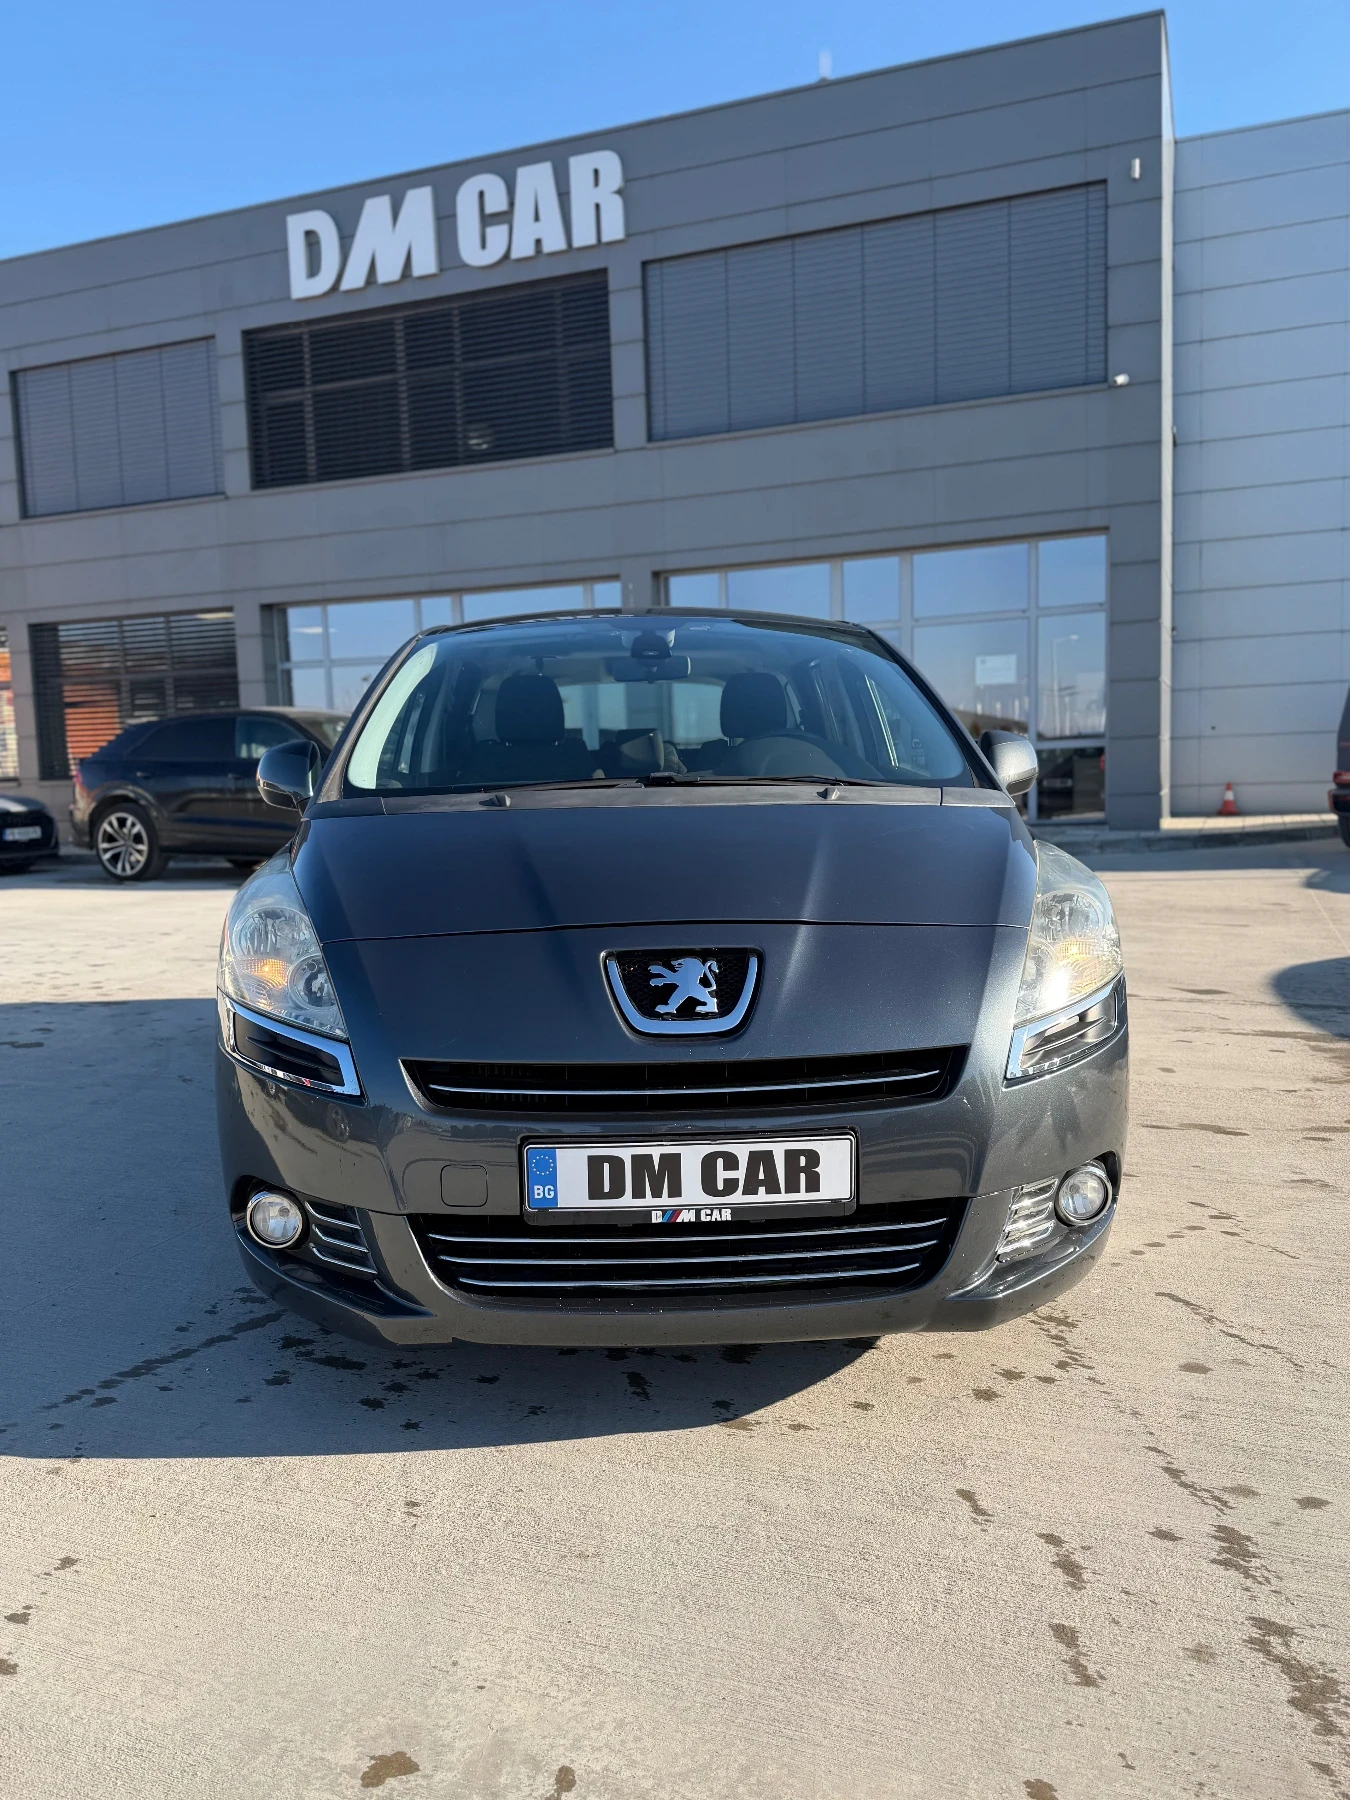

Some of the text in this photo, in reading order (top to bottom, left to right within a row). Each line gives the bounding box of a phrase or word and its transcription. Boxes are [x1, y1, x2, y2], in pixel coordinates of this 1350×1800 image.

[286, 150, 626, 300] DM CAR
[587, 1148, 821, 1201] DM CAR
[533, 1185, 555, 1199] BG
[700, 1208, 732, 1222] CAR
